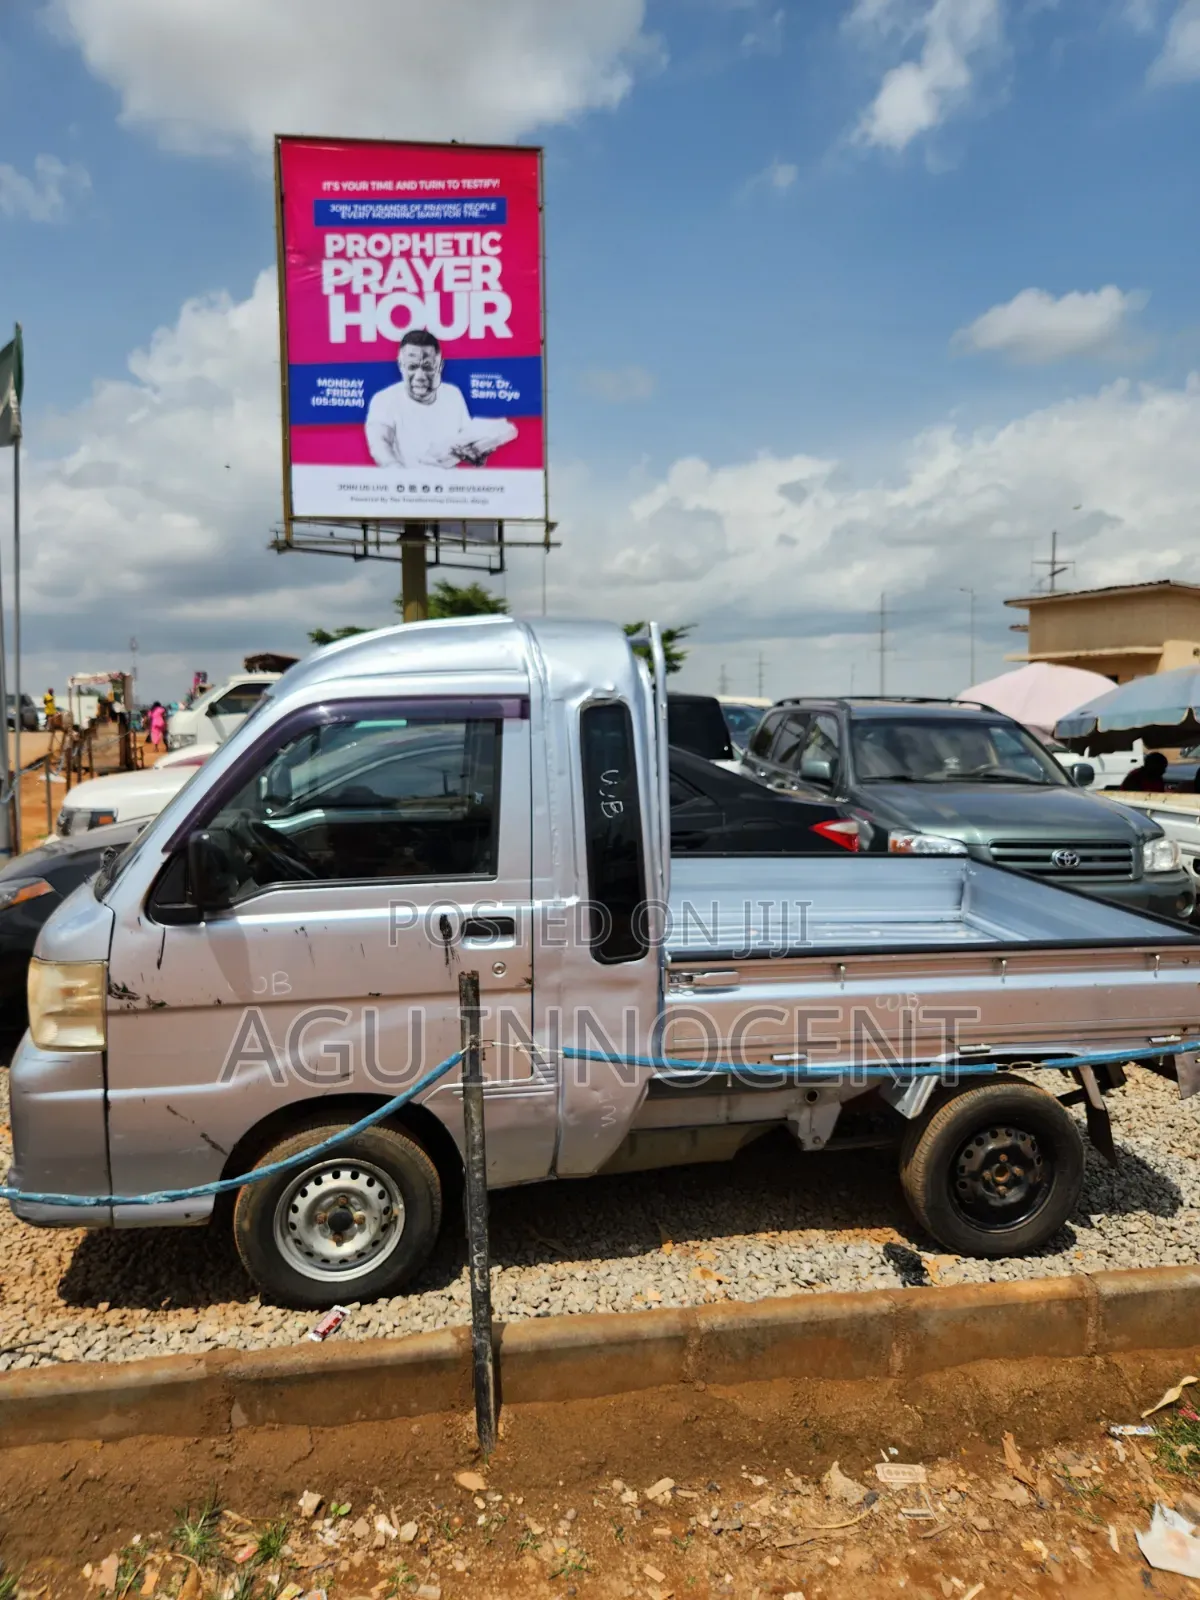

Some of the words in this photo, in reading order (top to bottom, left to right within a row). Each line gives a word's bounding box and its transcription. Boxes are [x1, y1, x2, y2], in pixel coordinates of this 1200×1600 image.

[322, 180, 340, 191] IT'S
[341, 180, 369, 191] YOUR
[370, 180, 394, 191] TIME
[395, 180, 418, 191] AND
[419, 179, 446, 190] TURN
[446, 179, 460, 190] TO
[461, 178, 501, 189] TESTIFY!
[329, 204, 352, 213] JOIN
[409, 203, 422, 212] OF
[463, 202, 497, 212] PEOPLE
[324, 231, 503, 258] PROPHETIC
[321, 256, 503, 295] PRAYER
[328, 290, 514, 343] HOUR
[317, 378, 364, 388] MONDAY
[471, 380, 495, 389] Rev.
[496, 380, 513, 389] Dr.
[326, 388, 364, 397] FRIDAY
[471, 389, 497, 399] Sam
[497, 390, 520, 402] Oye
